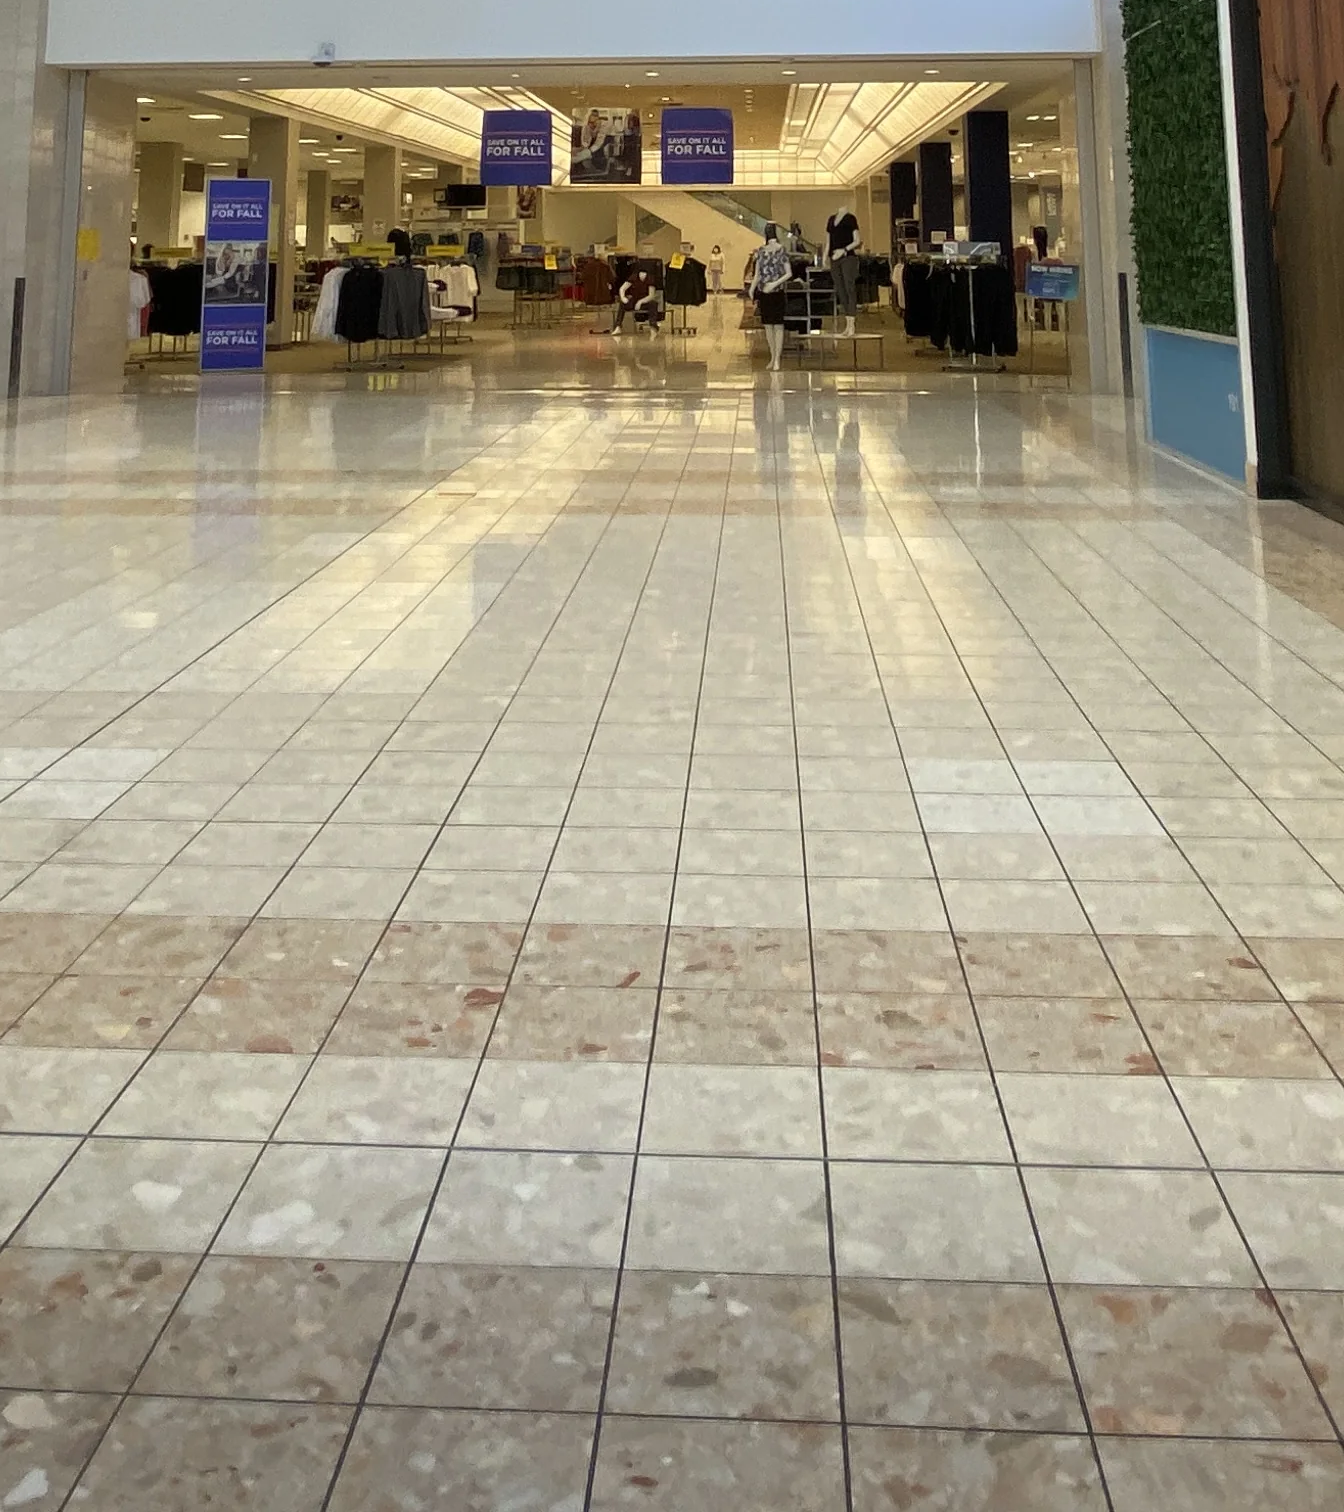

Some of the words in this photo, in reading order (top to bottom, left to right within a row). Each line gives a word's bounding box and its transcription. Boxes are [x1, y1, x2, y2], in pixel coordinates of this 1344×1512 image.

[486, 146, 510, 156] FOR
[514, 146, 545, 156] FALL
[667, 145, 692, 155] FOR
[696, 145, 726, 155] FALL
[211, 210, 234, 218] FOR
[237, 210, 263, 218] FALL
[206, 336, 229, 345] FOR
[231, 336, 257, 345] FALL
